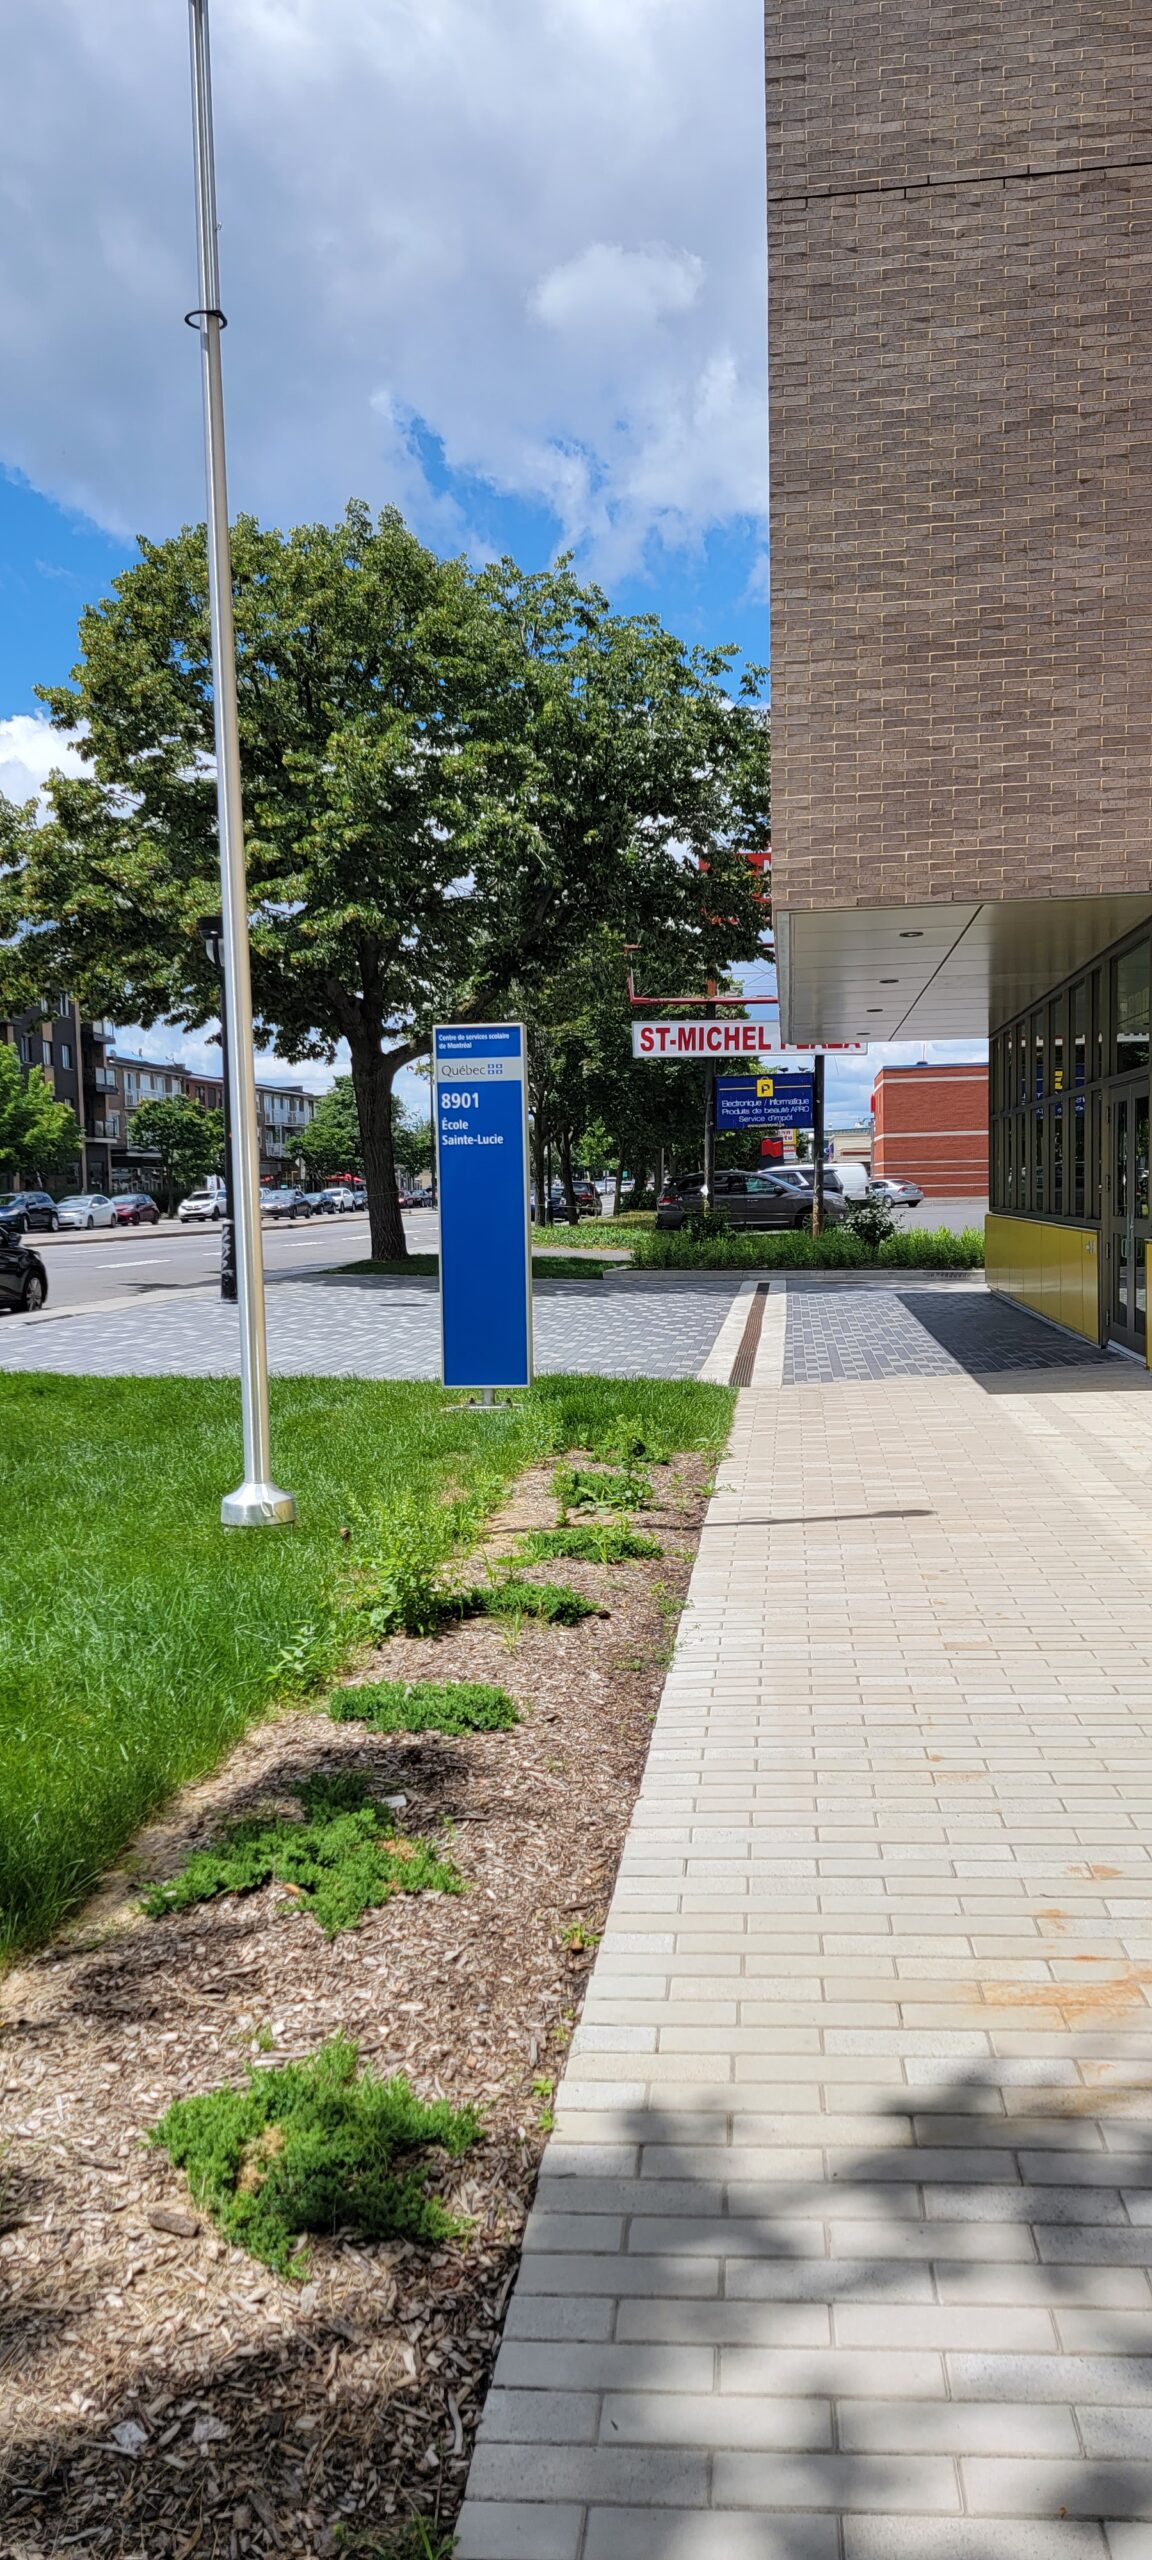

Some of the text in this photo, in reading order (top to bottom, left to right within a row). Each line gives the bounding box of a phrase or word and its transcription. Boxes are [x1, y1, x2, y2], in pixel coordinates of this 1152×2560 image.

[489, 1032, 510, 1040] scolaire
[640, 1026, 772, 1052] ST-MICHEL
[441, 1064, 485, 1077] Québec
[441, 1092, 479, 1109] 8901
[769, 1098, 809, 1106] Informatique
[790, 1105, 809, 1113] AFRO
[442, 1117, 469, 1130] École
[738, 1114, 793, 1123] Service d'impôt
[442, 1134, 504, 1146] Sainte-Lucie
